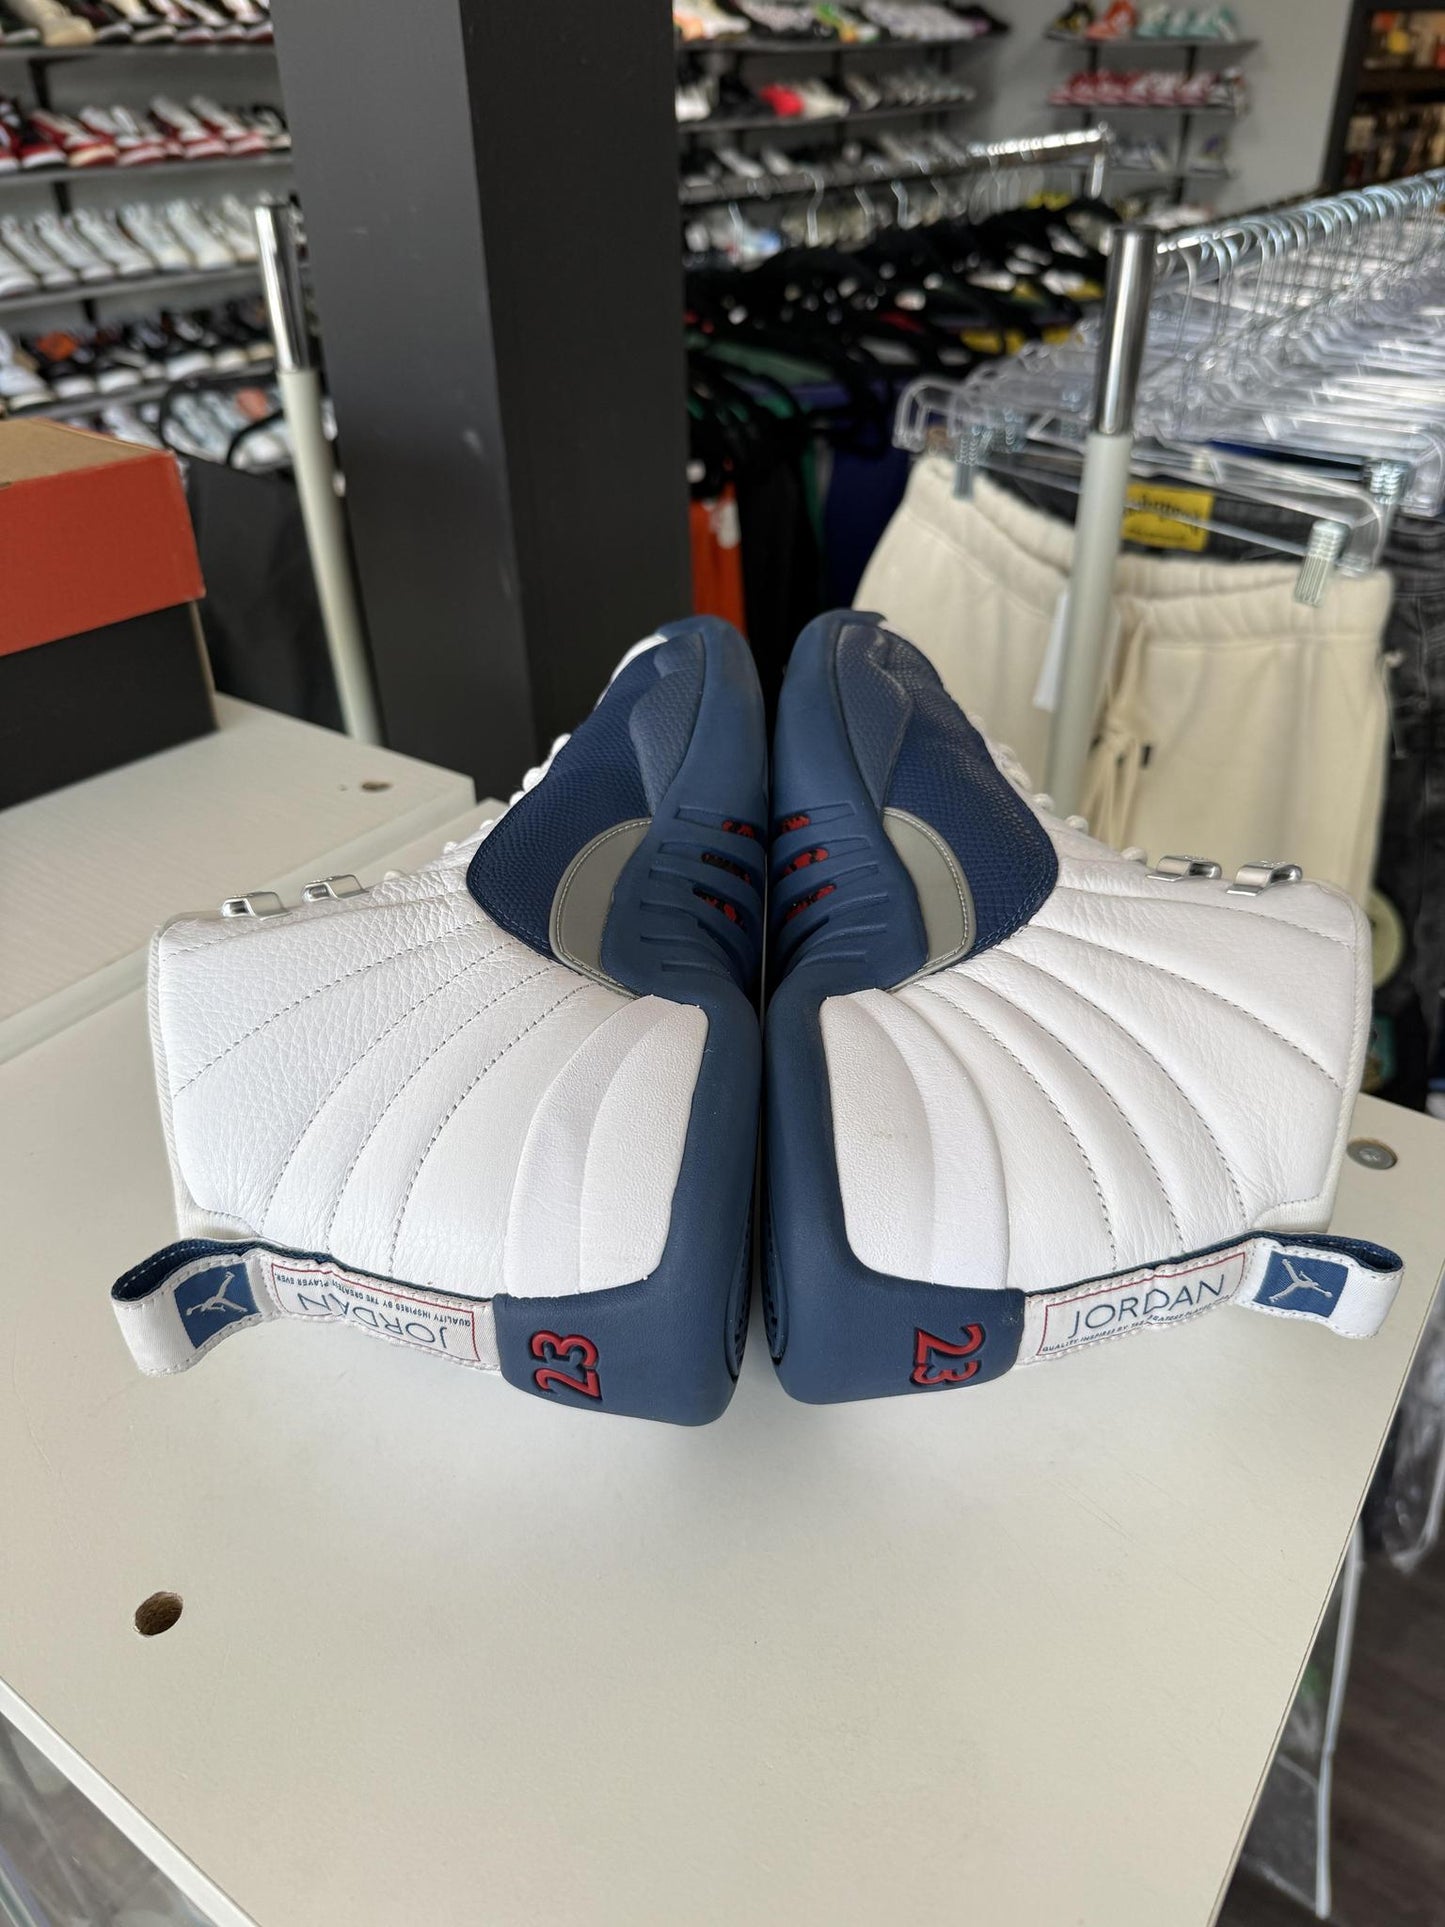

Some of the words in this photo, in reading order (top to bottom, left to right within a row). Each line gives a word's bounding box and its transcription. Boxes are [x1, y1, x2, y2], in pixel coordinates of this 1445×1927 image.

[296, 1279, 329, 1288] PLAYER
[366, 1294, 380, 1305] THE
[382, 1300, 393, 1309] BY
[1067, 1274, 1225, 1339] JORDAN
[395, 1302, 431, 1318] INSPIRED
[297, 1292, 448, 1349] JORDAN
[433, 1313, 471, 1327] QUALITY
[911, 1323, 985, 1385] 23
[530, 1330, 602, 1400] 23
